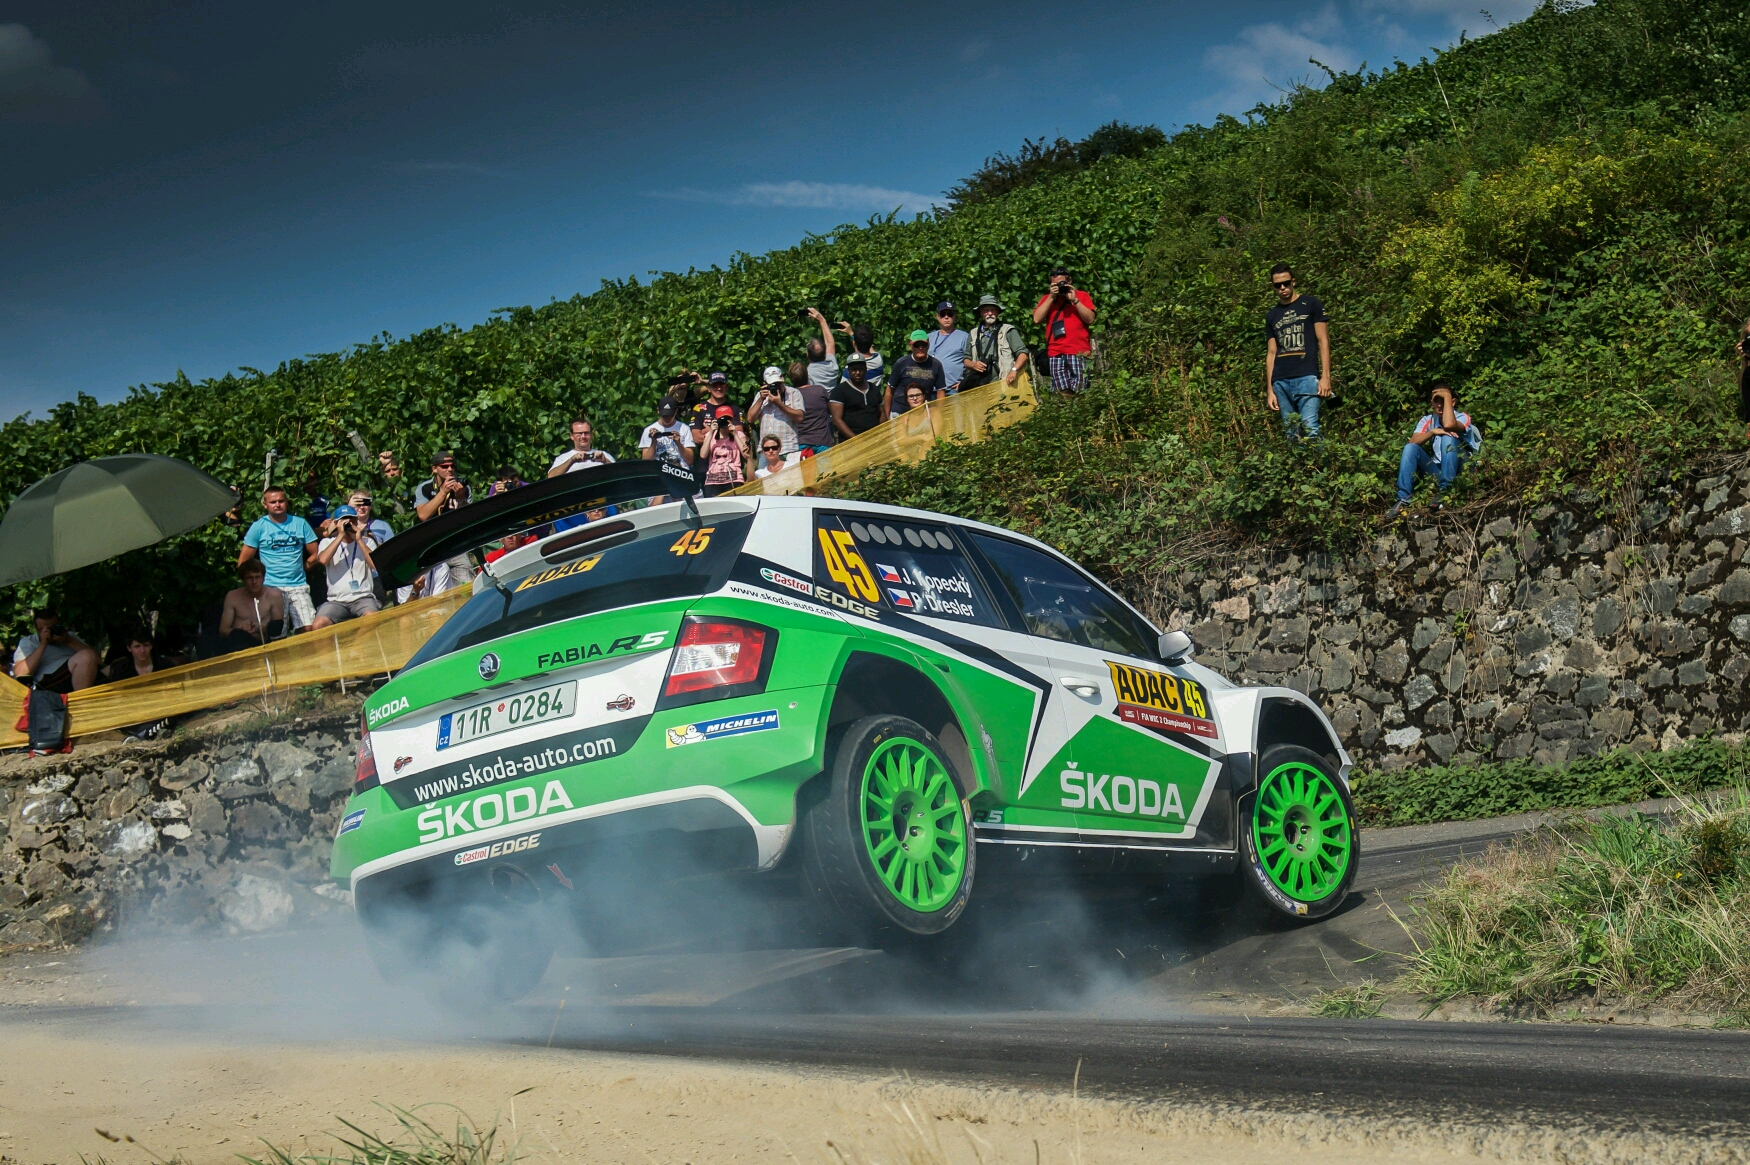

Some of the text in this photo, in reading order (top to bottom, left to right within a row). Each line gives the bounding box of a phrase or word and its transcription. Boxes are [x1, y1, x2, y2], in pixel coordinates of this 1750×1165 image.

[662, 463, 695, 481] ŠKODA
[669, 527, 716, 556] 45
[522, 556, 596, 589] ADAC
[817, 527, 880, 603] 45
[902, 567, 916, 586] J.
[730, 586, 836, 618] www.skoda-auto.com
[773, 572, 881, 621] Castrol EDGE
[537, 630, 670, 669] FABIA R5
[1116, 664, 1206, 719] ADAC 45
[369, 696, 410, 726] ŠKODA
[456, 688, 563, 739] 11R 0284
[706, 714, 777, 733] MICHELIN
[439, 735, 449, 746] CZ
[414, 735, 617, 802] www.skoda-auto.com
[1060, 761, 1186, 820] ŠKODA
[416, 779, 574, 844] ŠKODA
[462, 832, 542, 863] Castrol EDGE
